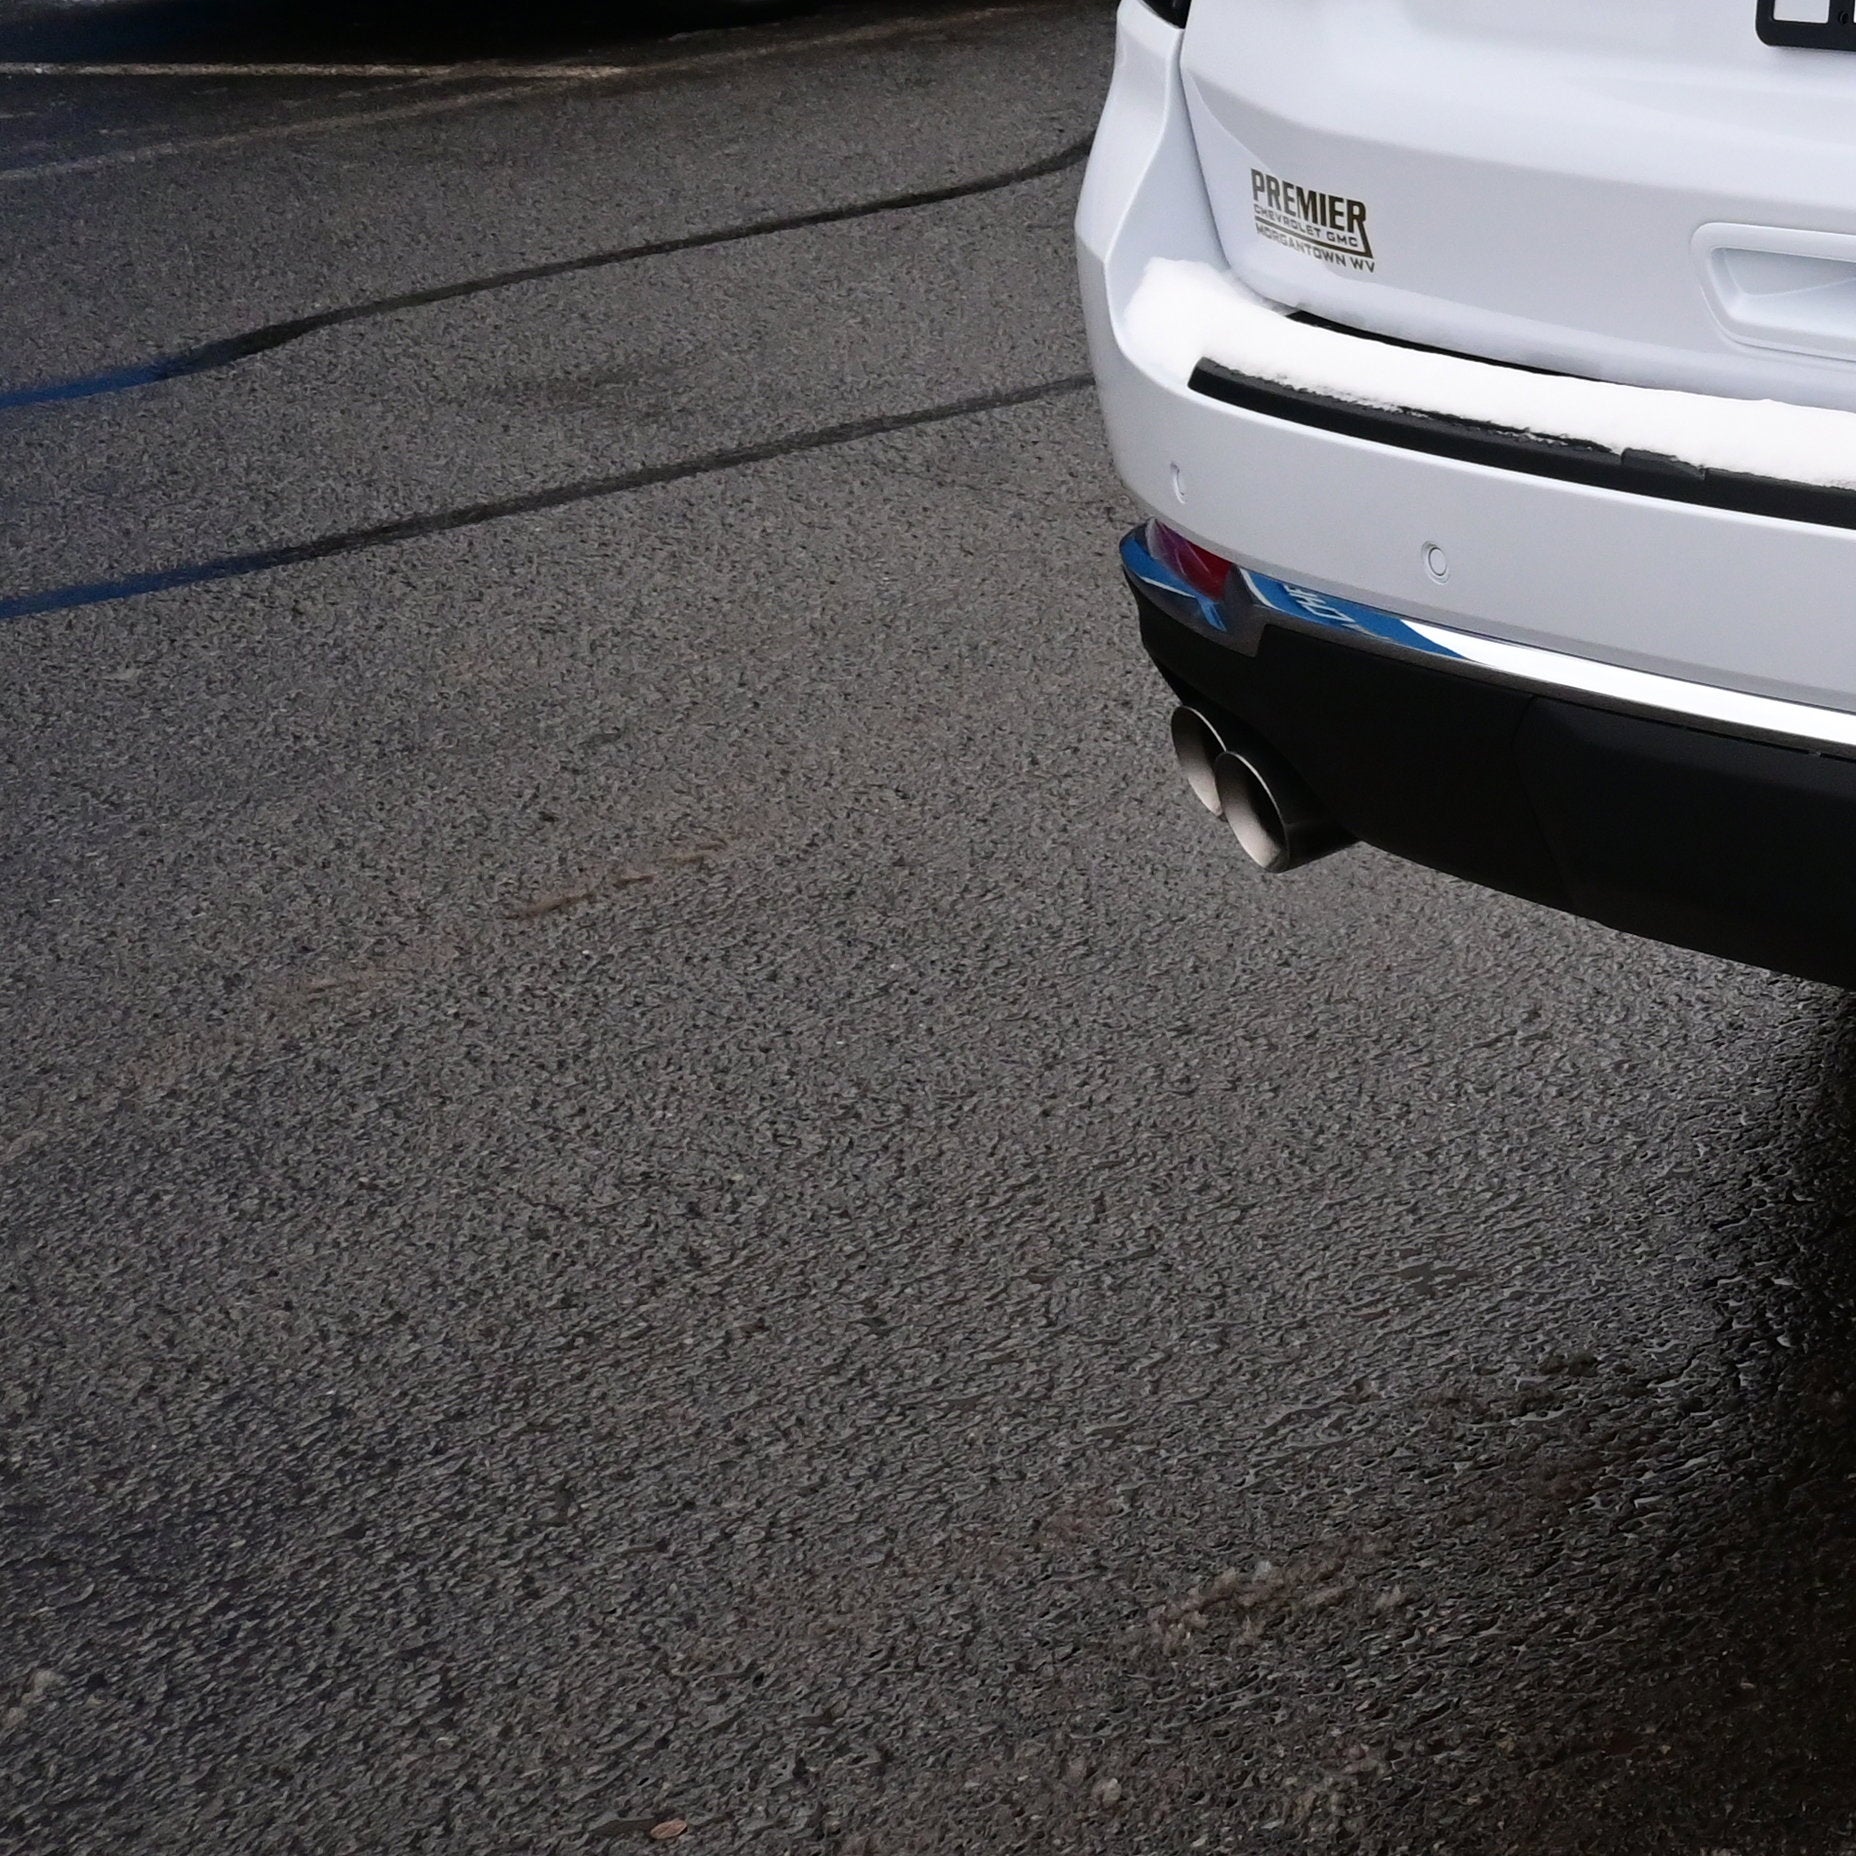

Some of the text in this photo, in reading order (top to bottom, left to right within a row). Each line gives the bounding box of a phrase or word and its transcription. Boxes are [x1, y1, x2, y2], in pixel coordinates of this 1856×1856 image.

[1250, 167, 1368, 234] PREMIER
[1326, 230, 1359, 248] GMC
[1349, 256, 1376, 274] WV
